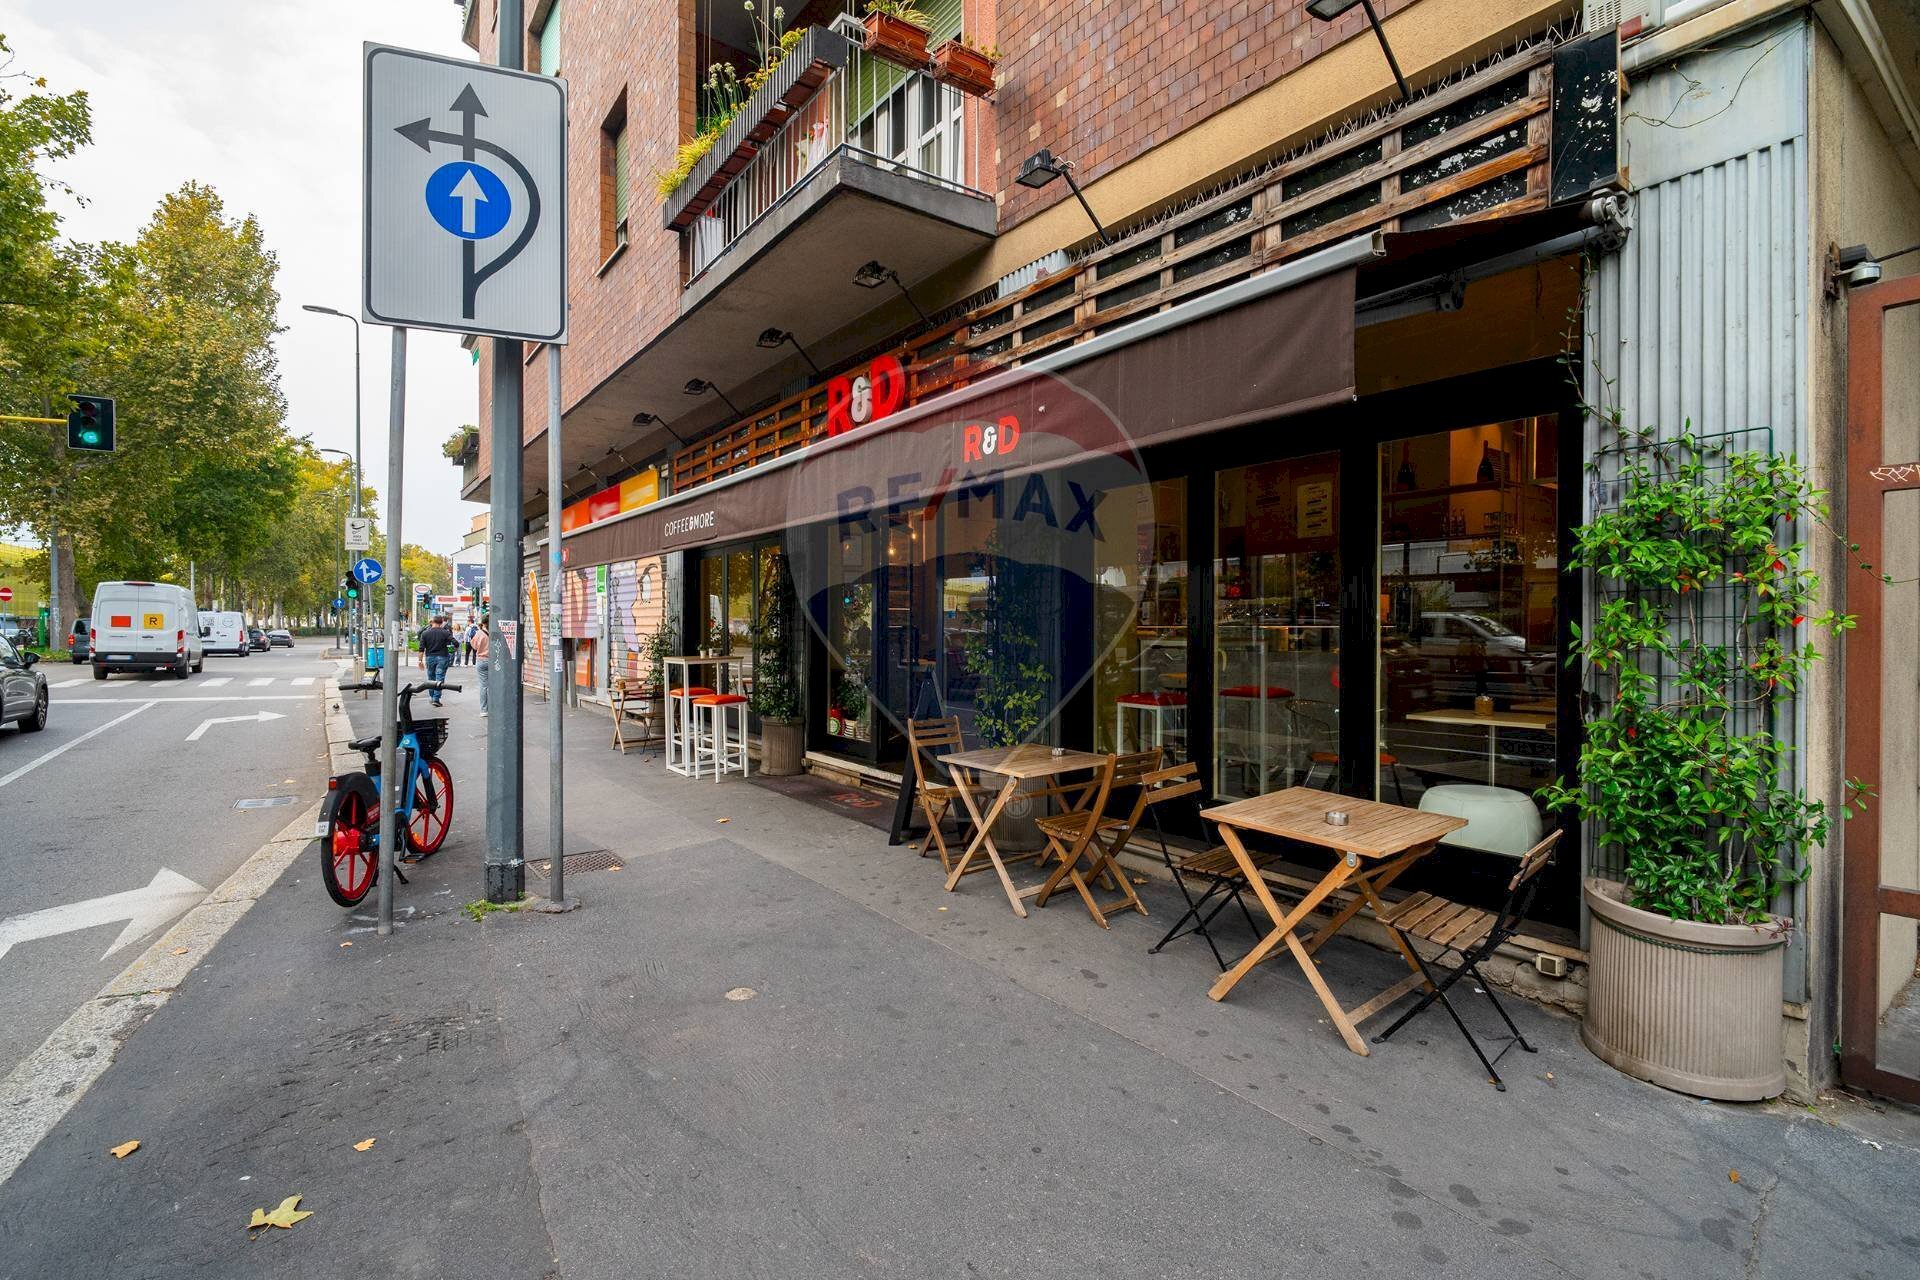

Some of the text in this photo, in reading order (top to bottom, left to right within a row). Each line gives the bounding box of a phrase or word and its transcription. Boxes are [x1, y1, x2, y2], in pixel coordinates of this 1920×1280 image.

[827, 355, 905, 436] R&D
[963, 415, 1021, 463] R&D
[150, 618, 158, 626] R
